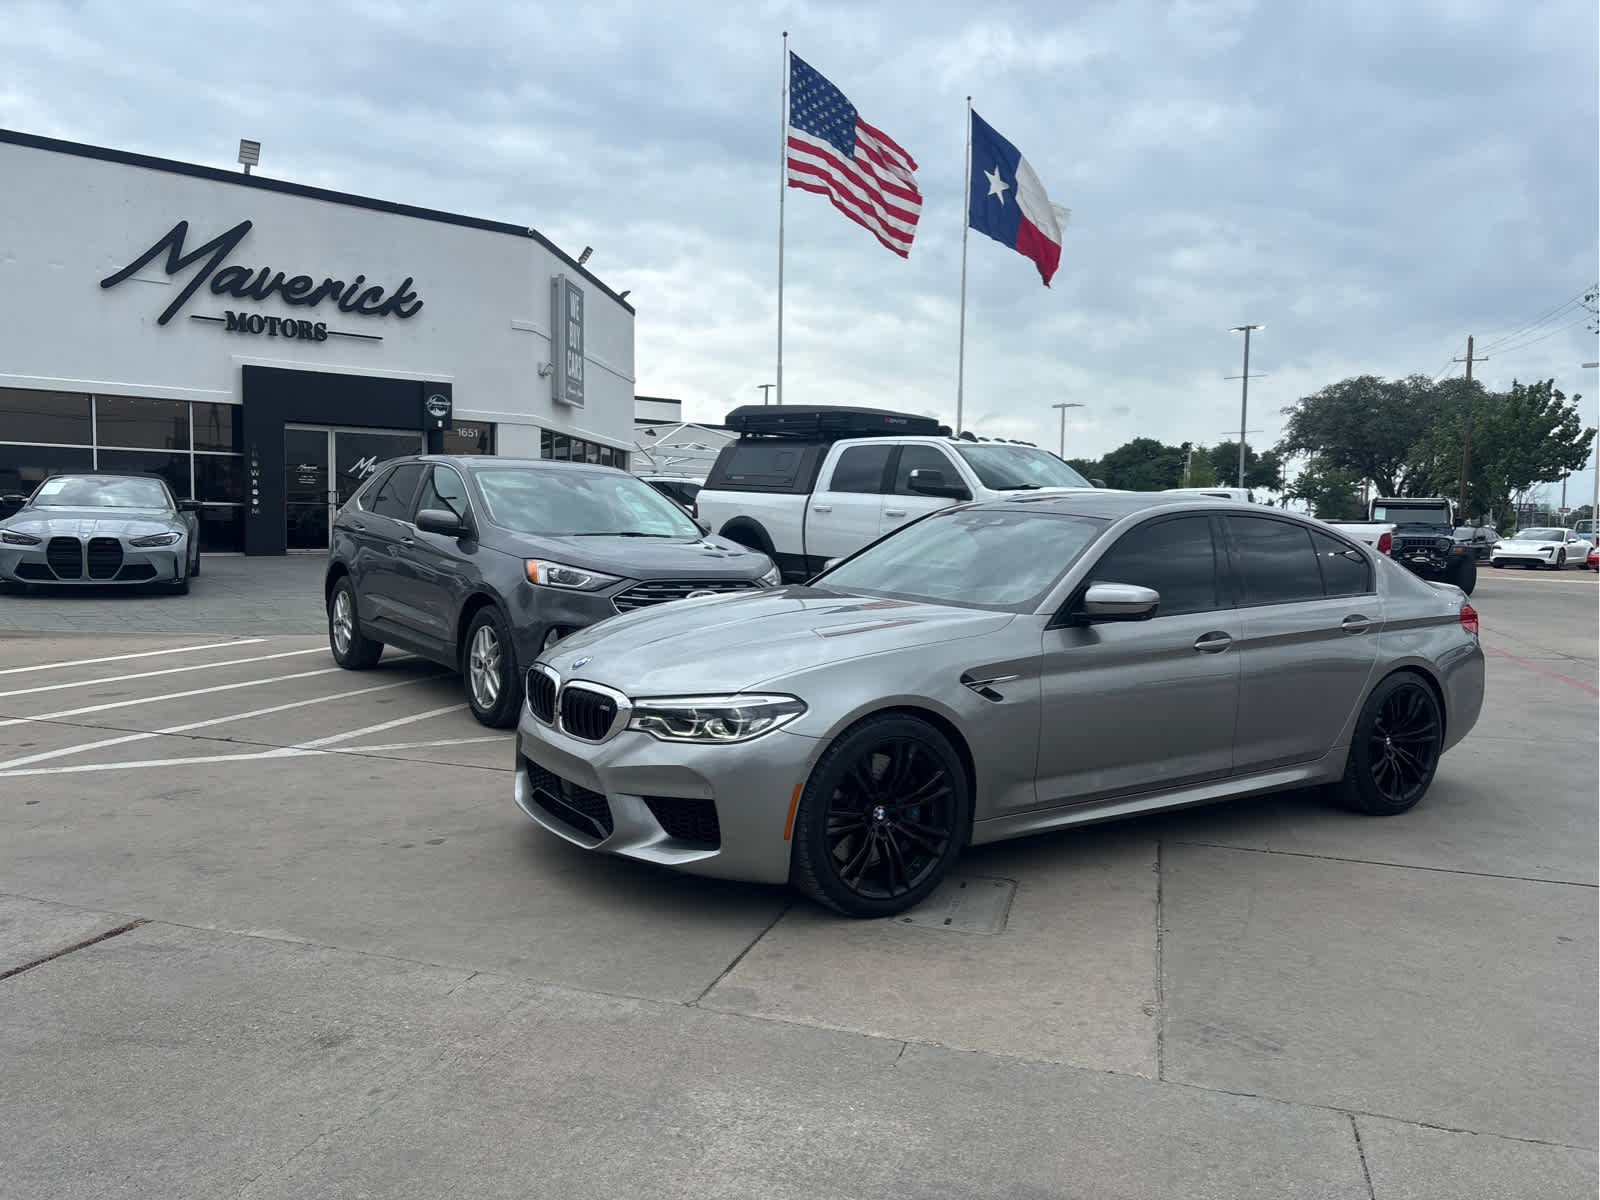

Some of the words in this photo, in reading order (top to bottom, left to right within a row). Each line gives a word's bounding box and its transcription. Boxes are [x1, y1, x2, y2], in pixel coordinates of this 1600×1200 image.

[100, 220, 423, 325] Maverick
[569, 290, 580, 320] WE
[225, 311, 328, 341] MOTORS
[569, 321, 581, 351] BUY
[456, 427, 478, 438] 1651
